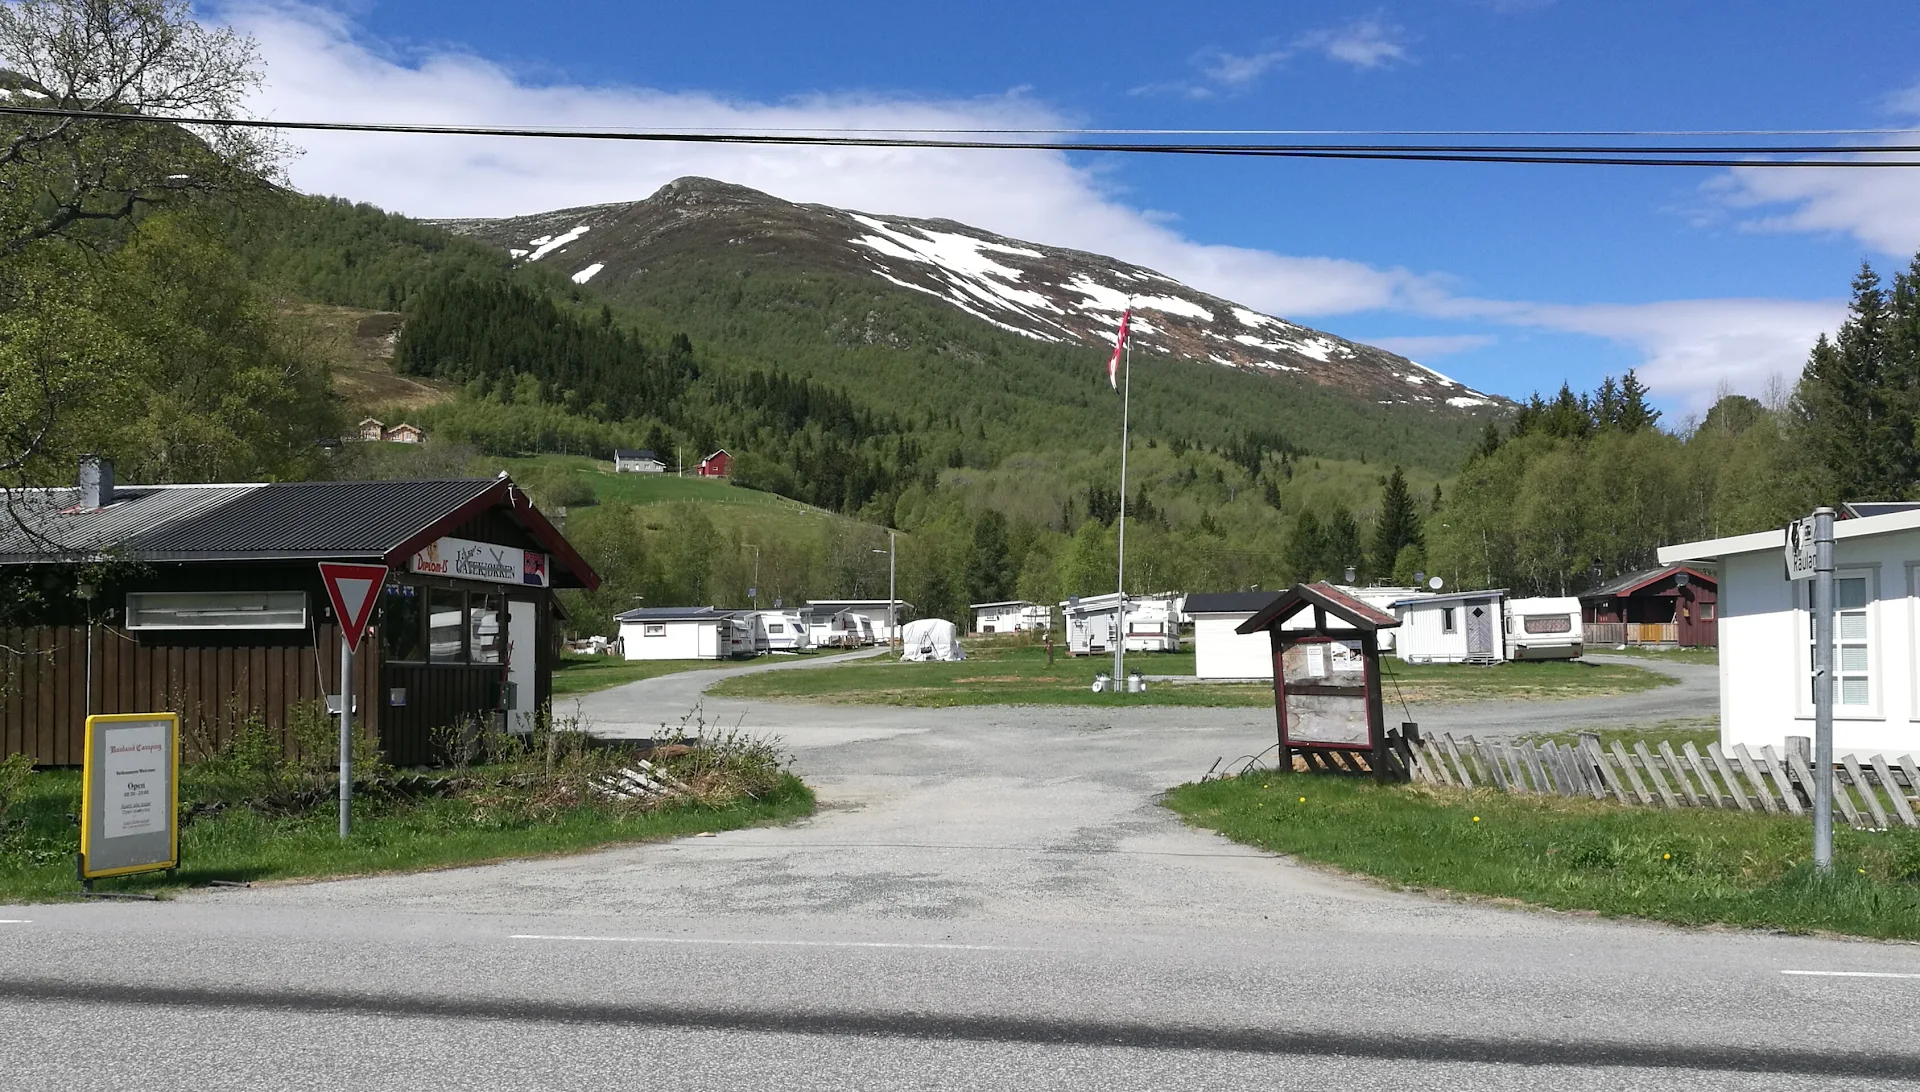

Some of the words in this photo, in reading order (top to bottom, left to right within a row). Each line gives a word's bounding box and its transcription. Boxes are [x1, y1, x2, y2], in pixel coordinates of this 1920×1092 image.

[1793, 552, 1816, 572] Raulan
[136, 743, 162, 754] Camping
[127, 782, 145, 790] Open
